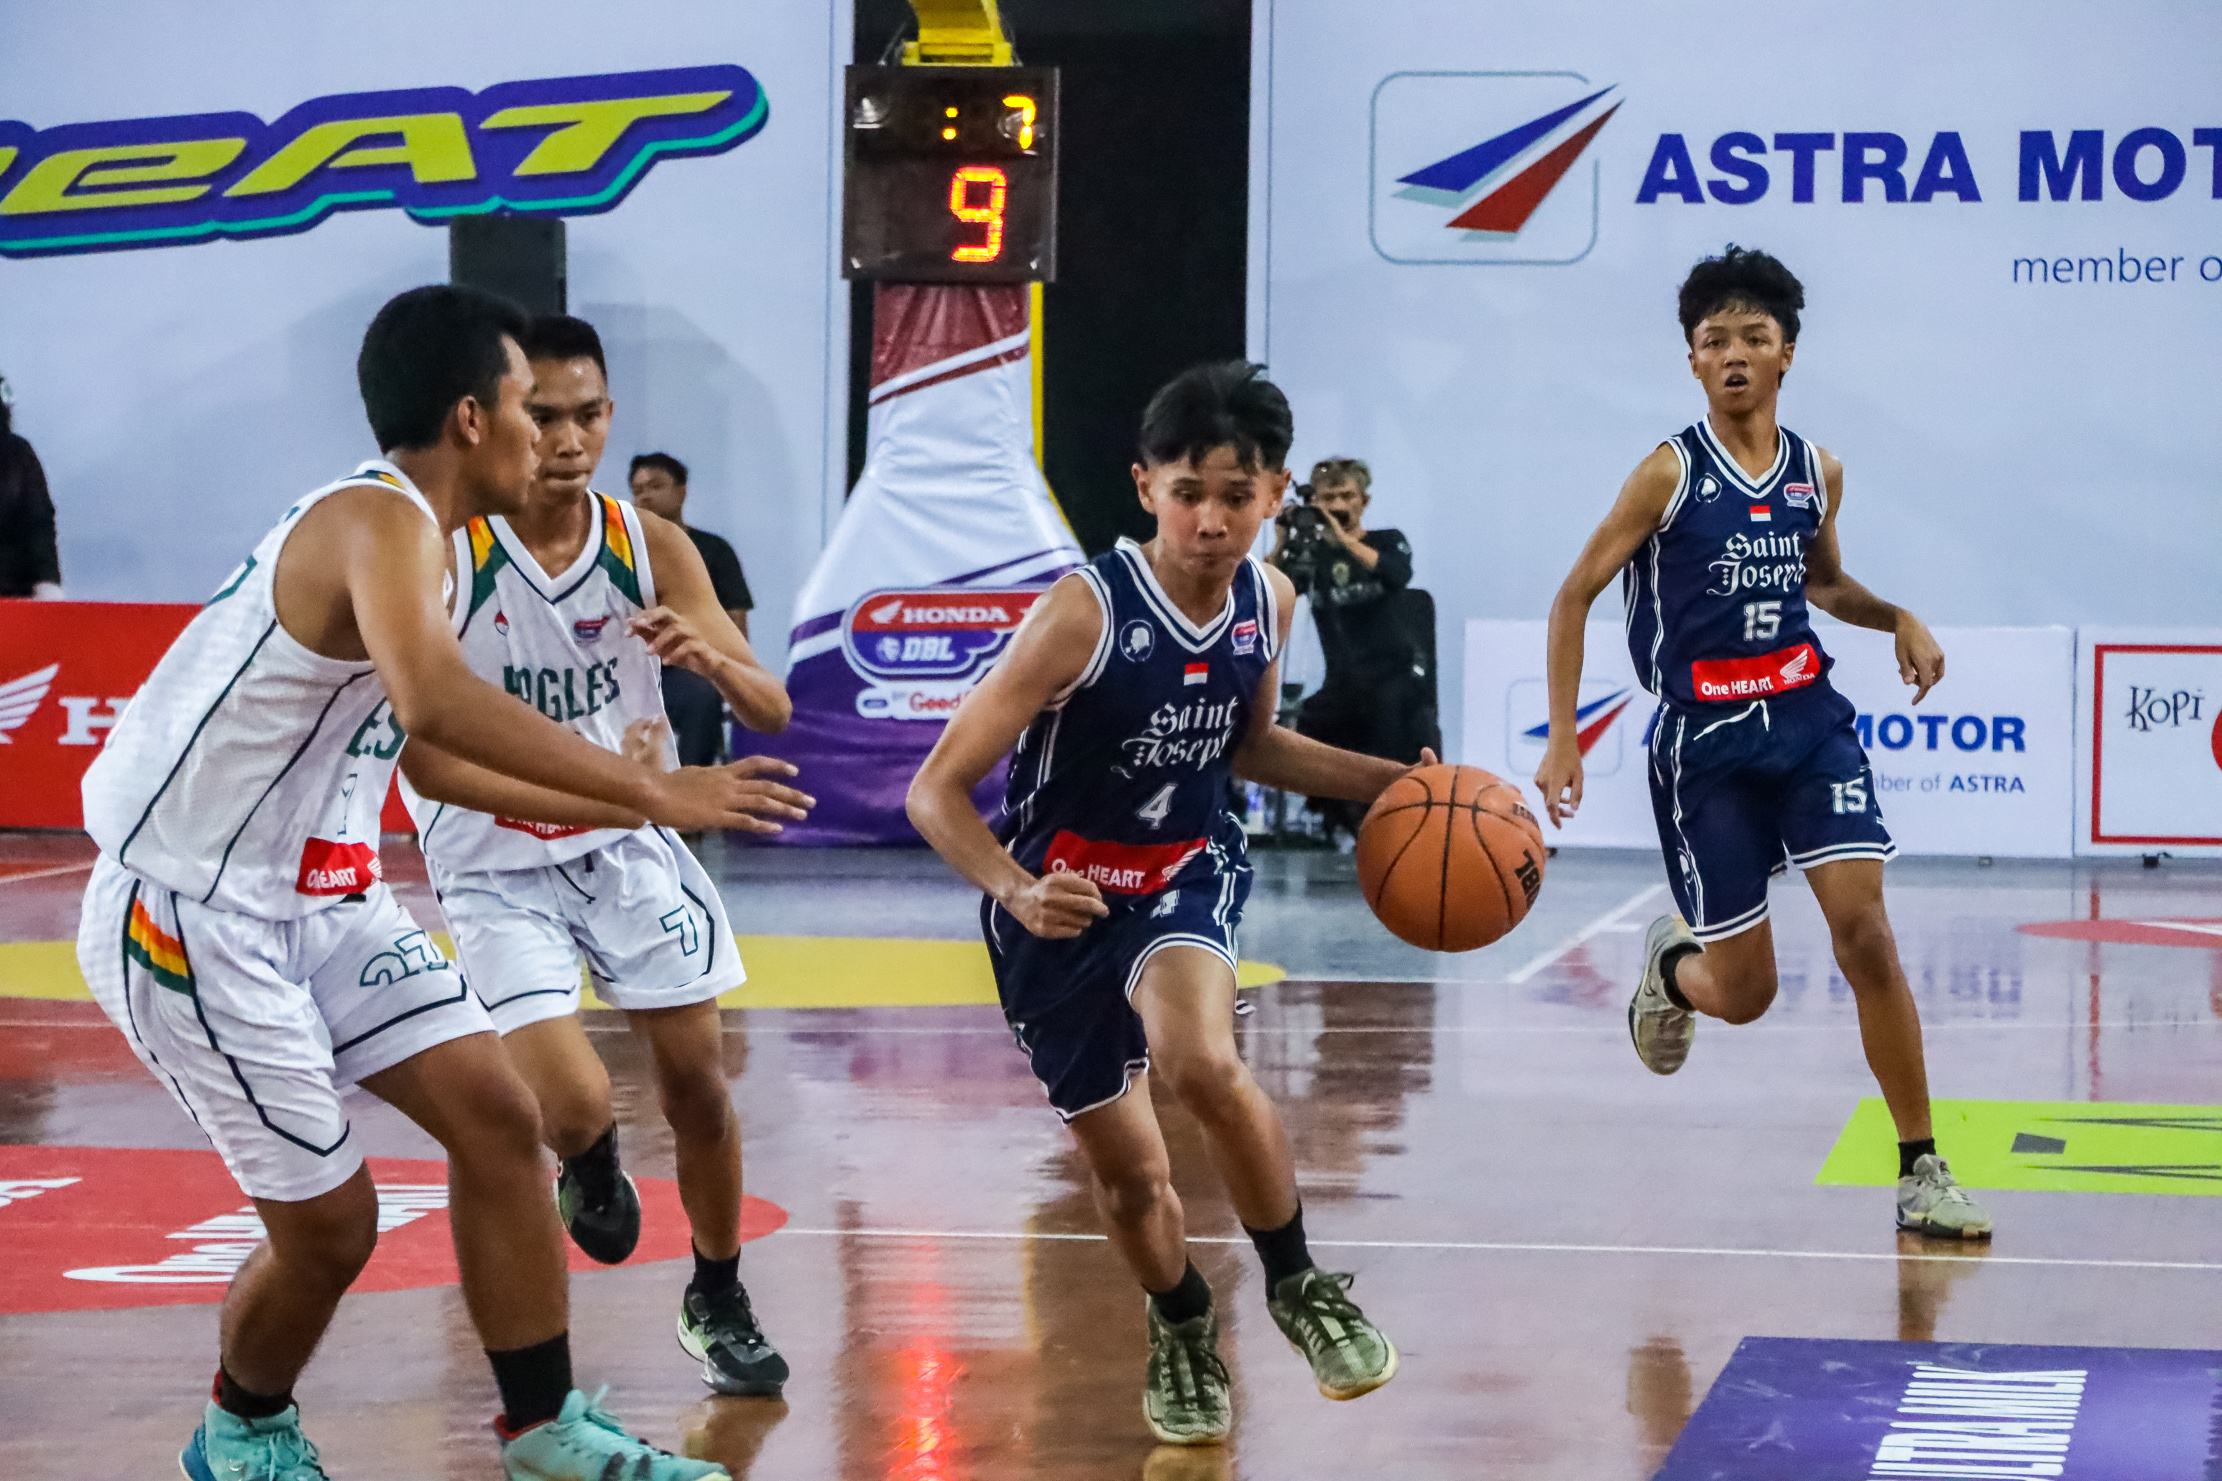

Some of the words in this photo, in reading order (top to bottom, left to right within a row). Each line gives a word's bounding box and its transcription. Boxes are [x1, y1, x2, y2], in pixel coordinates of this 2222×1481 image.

[1634, 131, 1983, 205] ASTRA
[949, 166, 1008, 262] 9
[2012, 248, 2185, 284] member
[1721, 531, 1800, 560] Saint
[1706, 553, 1807, 596] Joseph
[903, 607, 1011, 624] HONDA
[1743, 601, 1782, 641] 15
[901, 635, 956, 662] DBL
[1701, 681, 1729, 696] One
[1141, 696, 1239, 737] Saint
[1830, 777, 1868, 815] 15
[1920, 773, 1940, 792] of
[1949, 775, 2026, 793] ASTRA
[1136, 783, 1178, 829] 4
[659, 905, 699, 957] 7
